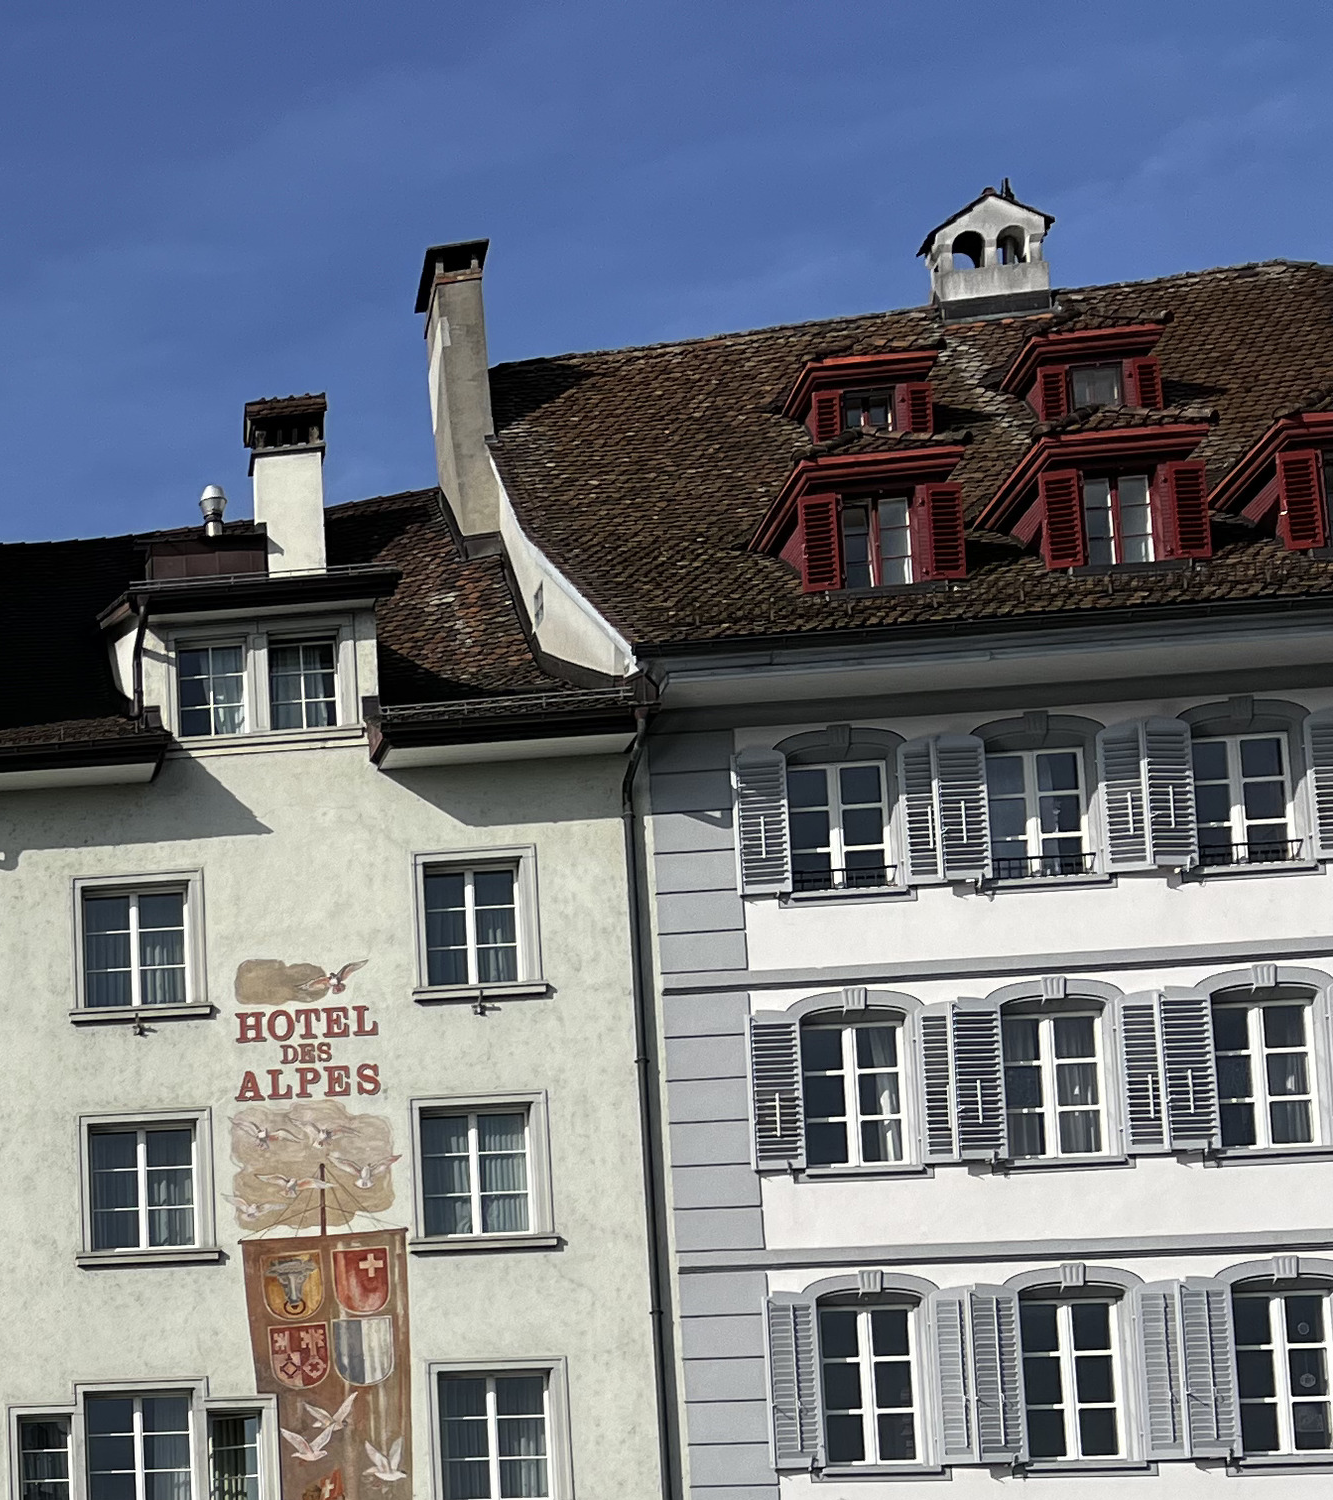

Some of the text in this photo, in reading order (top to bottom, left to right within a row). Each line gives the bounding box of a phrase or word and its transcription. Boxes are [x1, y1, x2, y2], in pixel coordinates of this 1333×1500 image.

[235, 1005, 379, 1043] HOTEL
[280, 1042, 332, 1065] DES
[235, 1063, 381, 1102] ALPES
